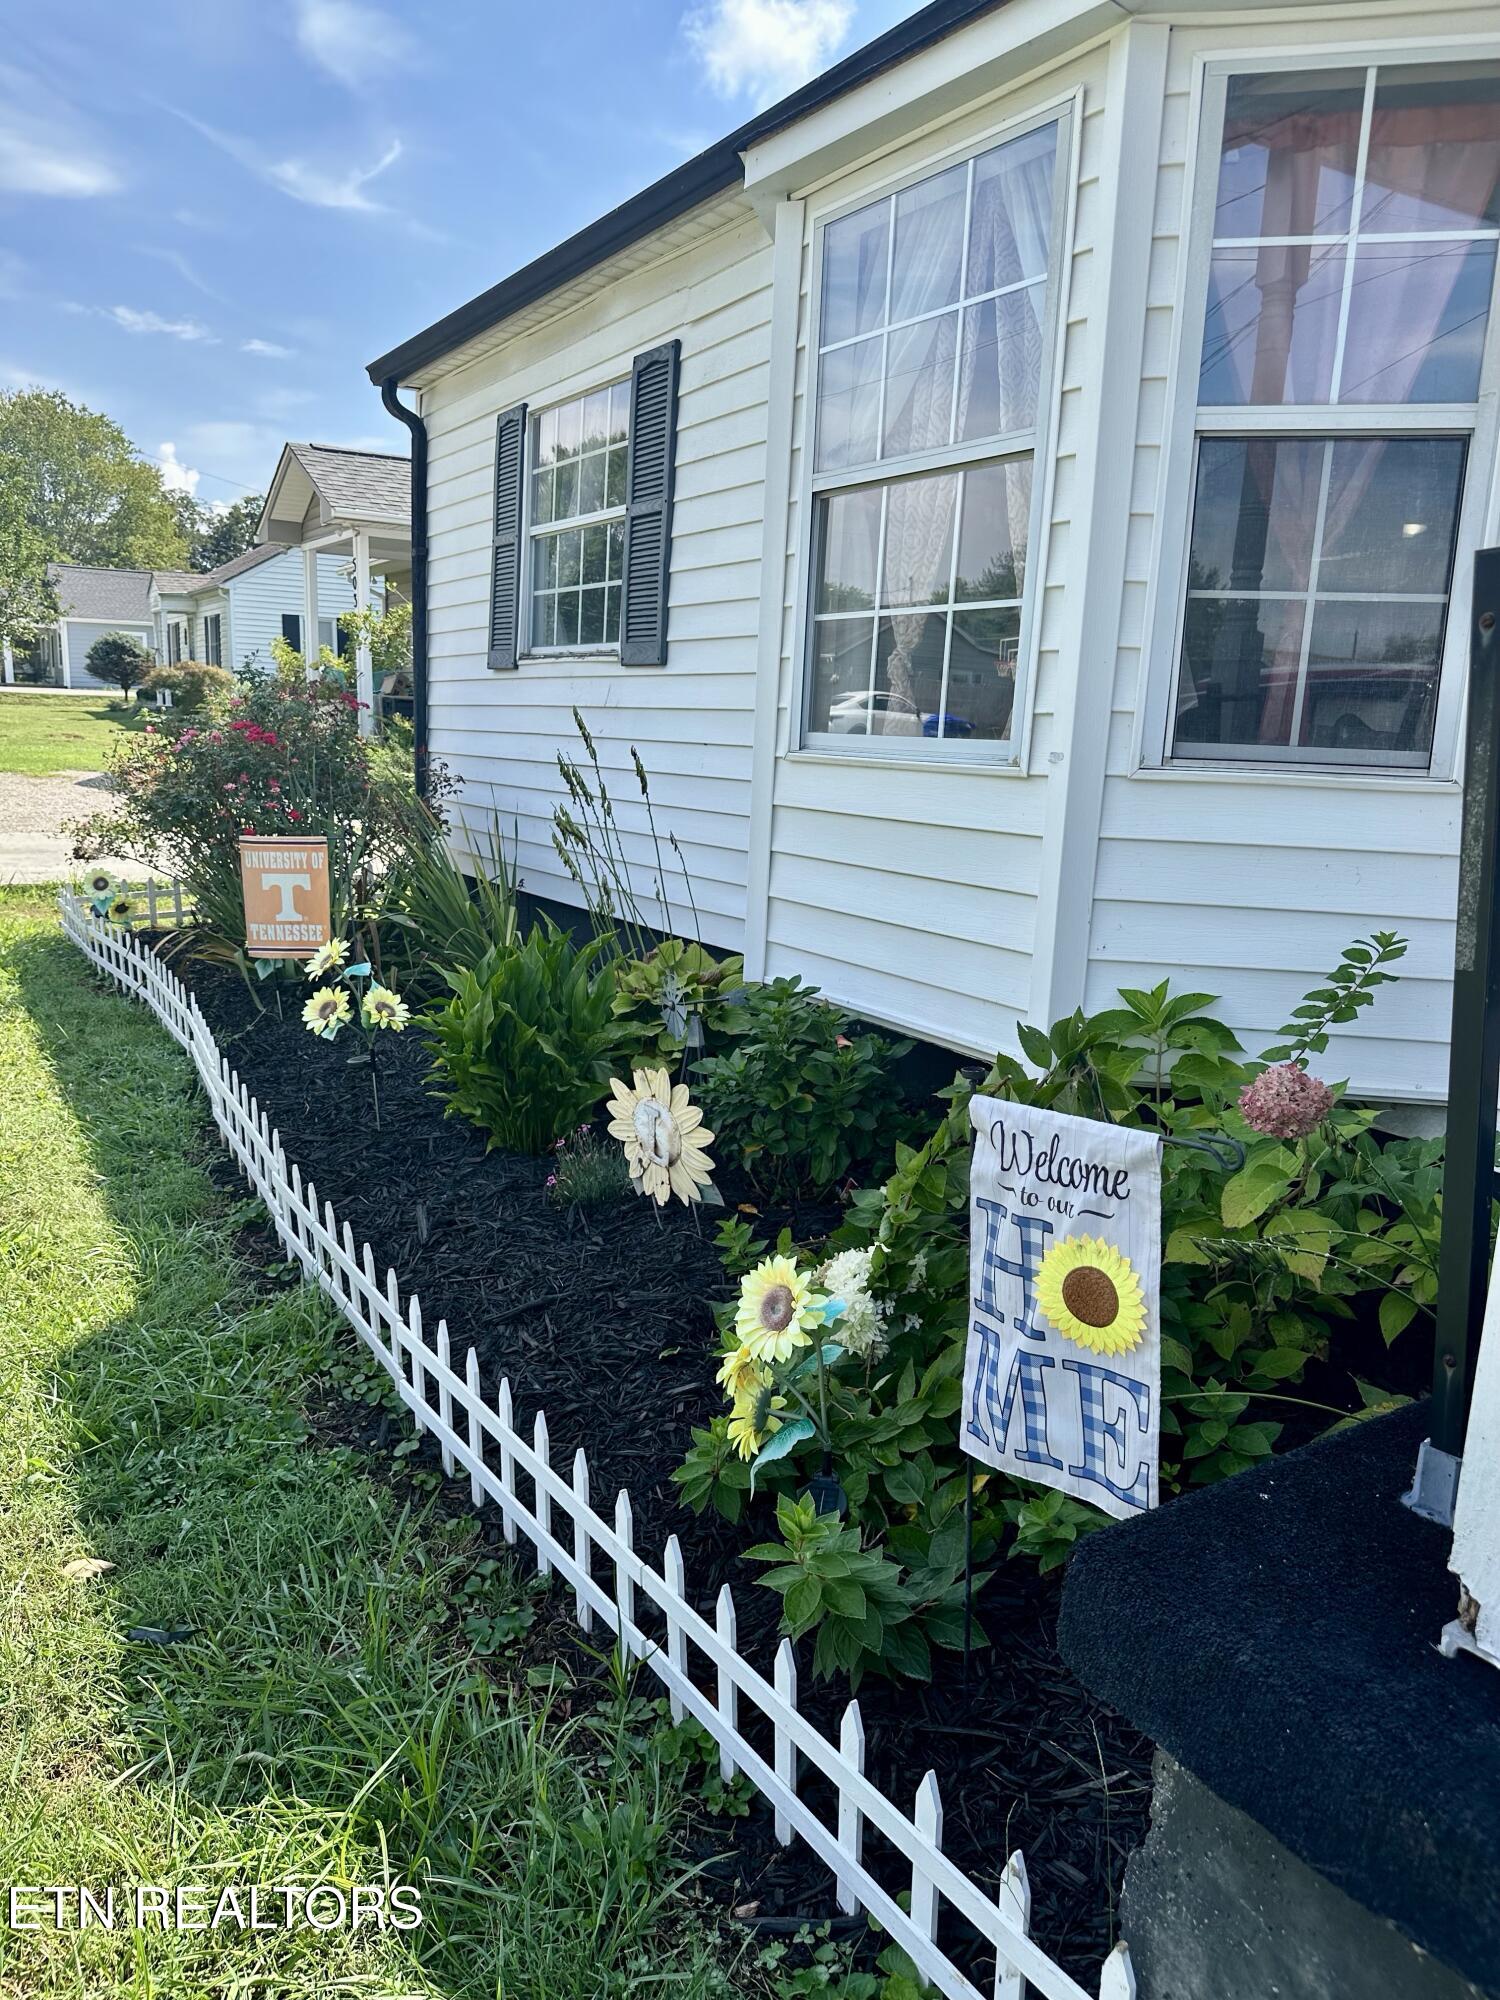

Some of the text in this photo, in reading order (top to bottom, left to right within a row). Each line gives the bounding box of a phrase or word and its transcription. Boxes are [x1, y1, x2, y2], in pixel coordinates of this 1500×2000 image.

[244, 851, 325, 869] UNIVERSITY OF
[261, 873, 312, 921] T
[249, 923, 324, 942] TENNESSEE
[990, 1119, 1131, 1200] Welcome
[1020, 1186, 1075, 1219] to our
